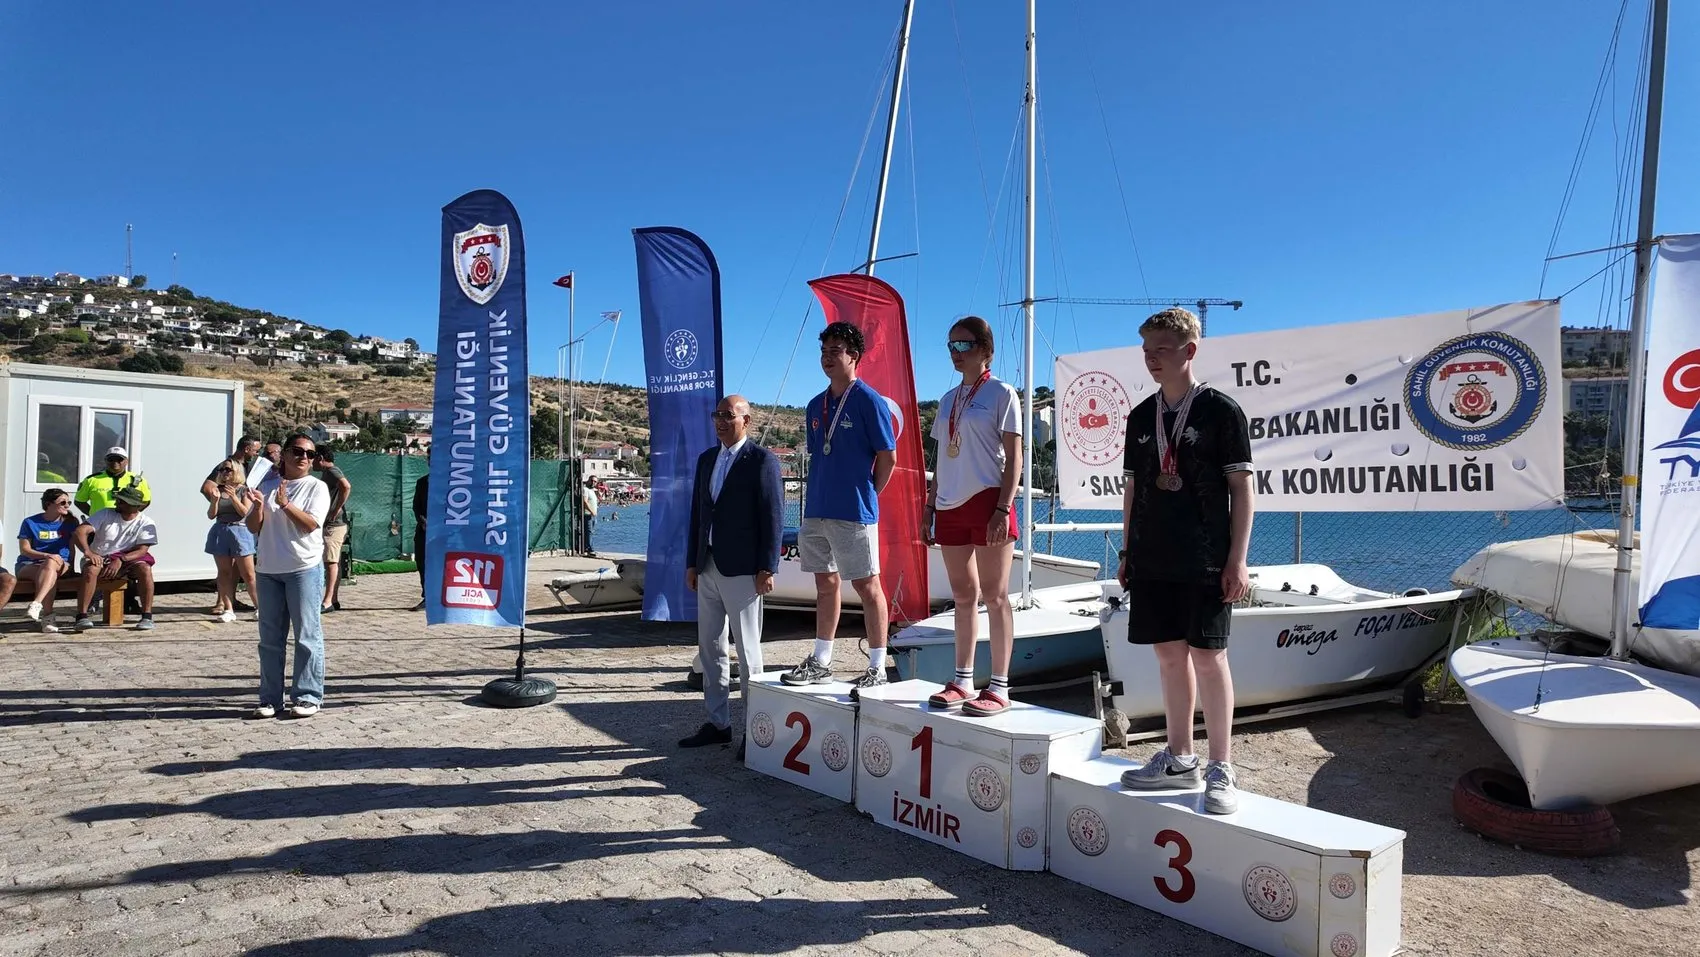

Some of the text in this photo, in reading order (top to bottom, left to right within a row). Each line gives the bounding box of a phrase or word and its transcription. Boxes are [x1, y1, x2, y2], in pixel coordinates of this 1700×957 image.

[1231, 360, 1281, 387] T.C.
[1413, 338, 1538, 397] SAHİL GÜVENLİK KOMUTANLIĞI
[1250, 397, 1400, 440] BAKANLIĞI
[1461, 434, 1487, 443] 1982
[1090, 475, 1127, 497] SAH
[1282, 456, 1494, 495] KOMUTANLIĞI
[1354, 614, 1396, 638] FOÇA
[783, 711, 811, 776] 2
[911, 726, 933, 800] 1
[893, 790, 961, 844] İZMİR
[1153, 829, 1196, 904] 3
